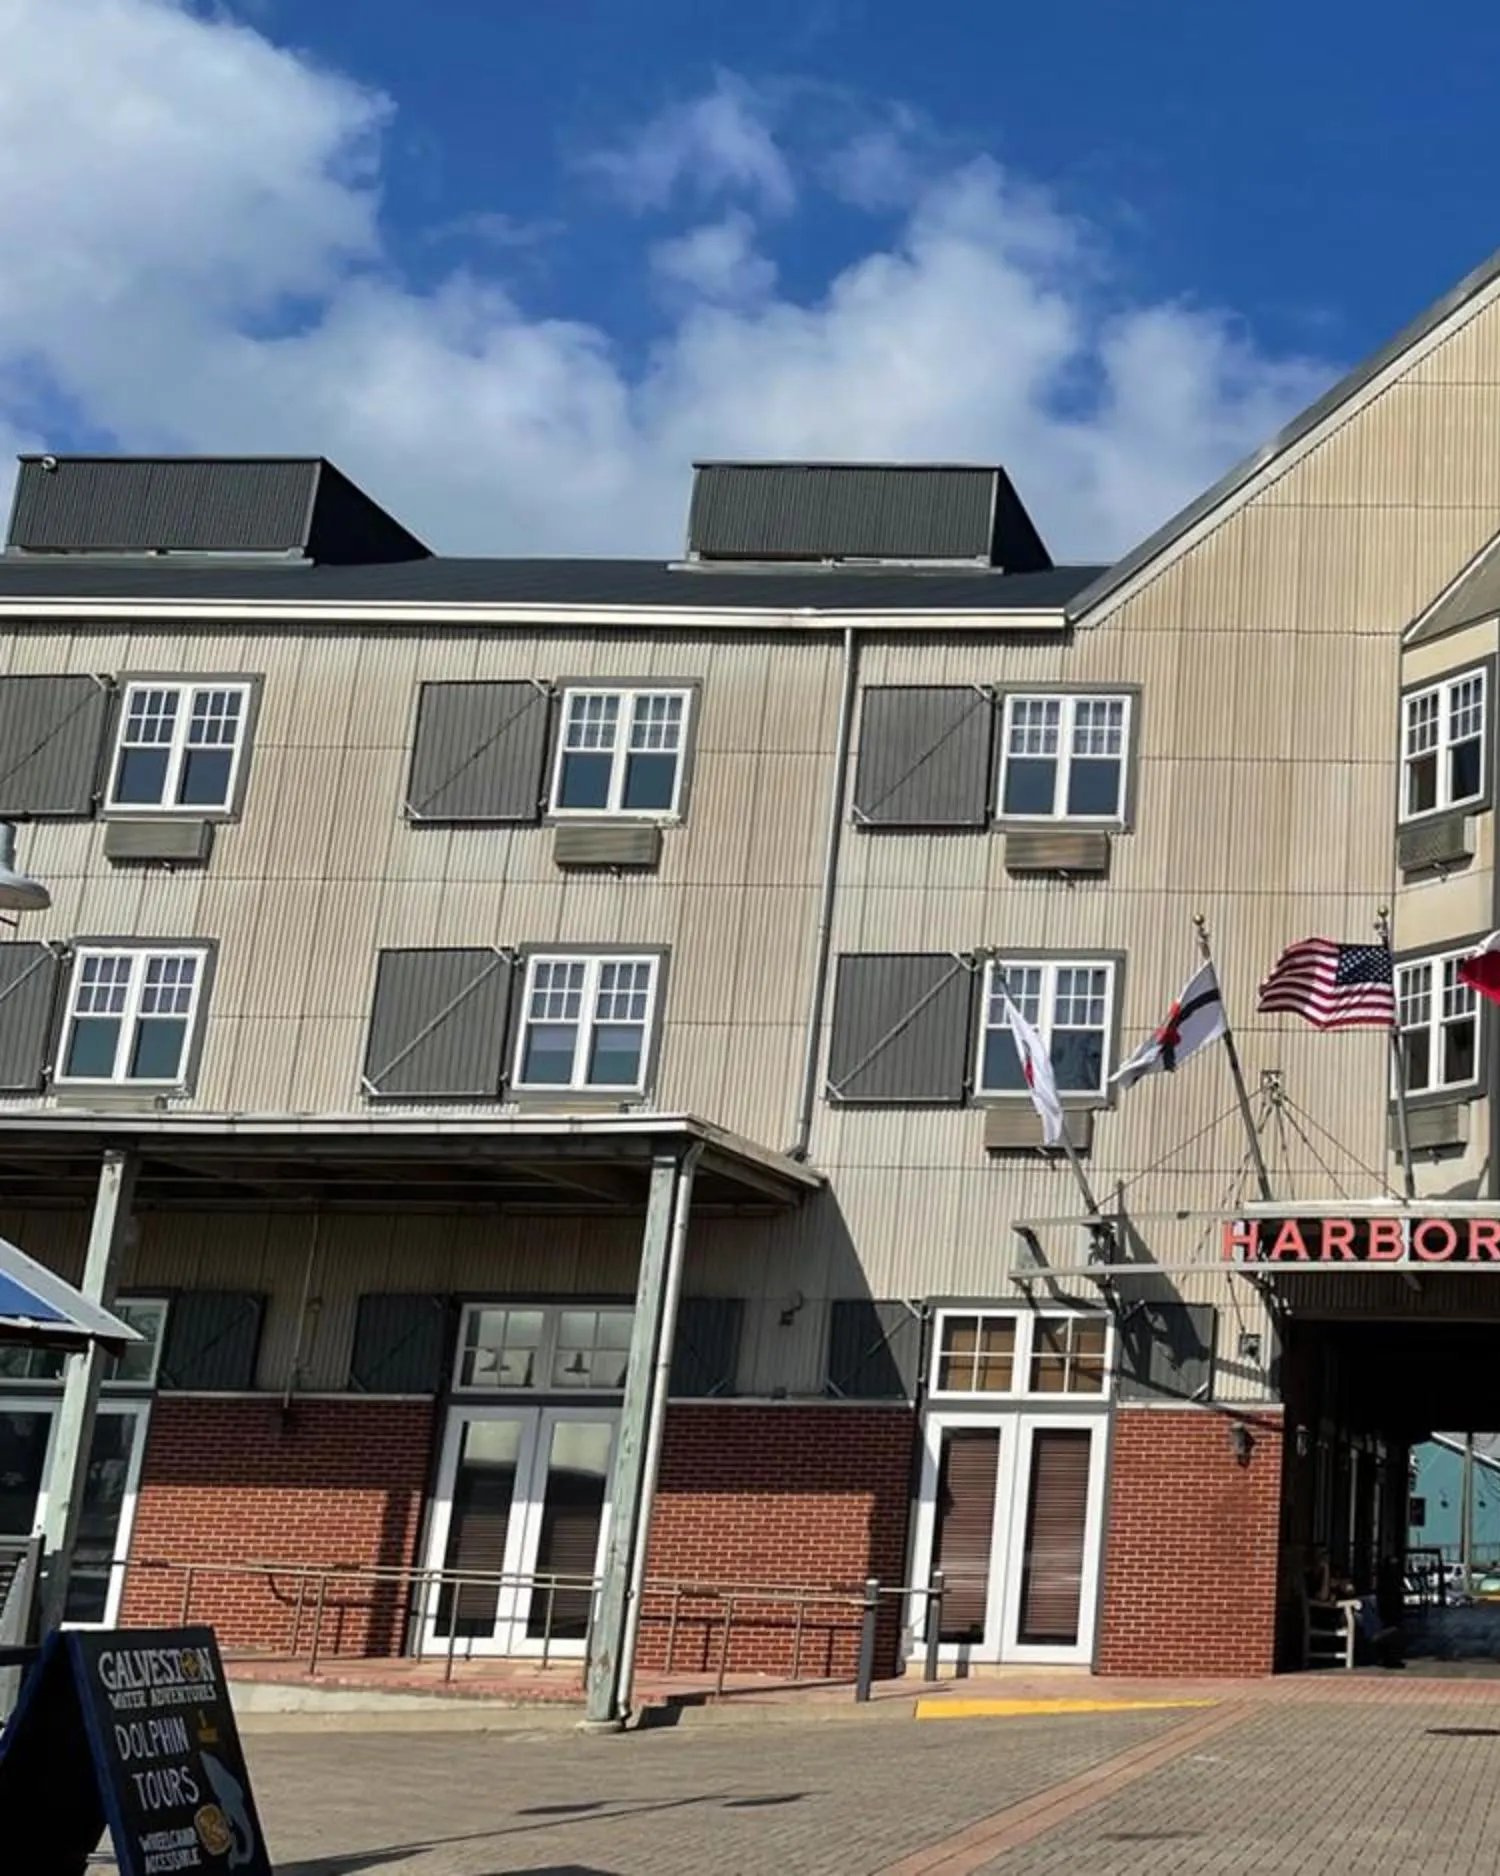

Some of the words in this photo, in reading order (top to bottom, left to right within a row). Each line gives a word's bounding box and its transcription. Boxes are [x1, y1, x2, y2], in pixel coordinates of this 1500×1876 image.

[98, 1648, 216, 1689] GALVESTON
[115, 1717, 190, 1760] DOLPHIN
[132, 1767, 200, 1811] TOURS
